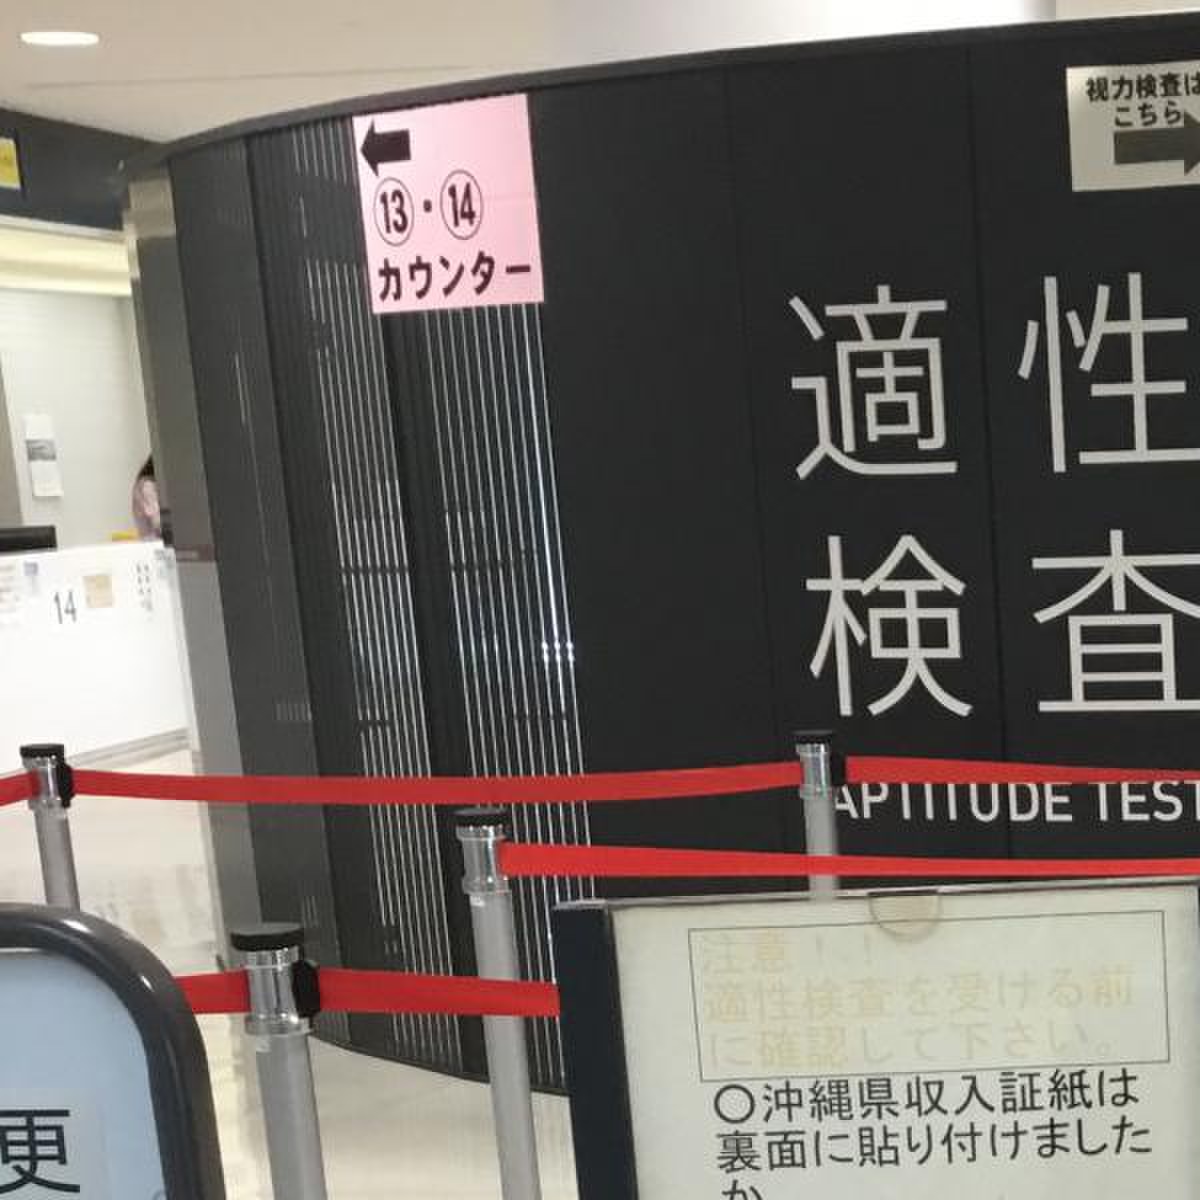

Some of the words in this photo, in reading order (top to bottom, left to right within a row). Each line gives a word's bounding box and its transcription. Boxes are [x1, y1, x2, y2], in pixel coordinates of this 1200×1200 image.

[1114, 101, 1182, 128] こちら
[377, 250, 532, 302] カウンター
[53, 588, 77, 625] 14
[834, 782, 1073, 822] APTITUDE
[702, 962, 1135, 1025] 適性検査を受ける前
[710, 1018, 1114, 1070] に確認して下さい。
[716, 1115, 1154, 1174] 裏面に貼り付けました
